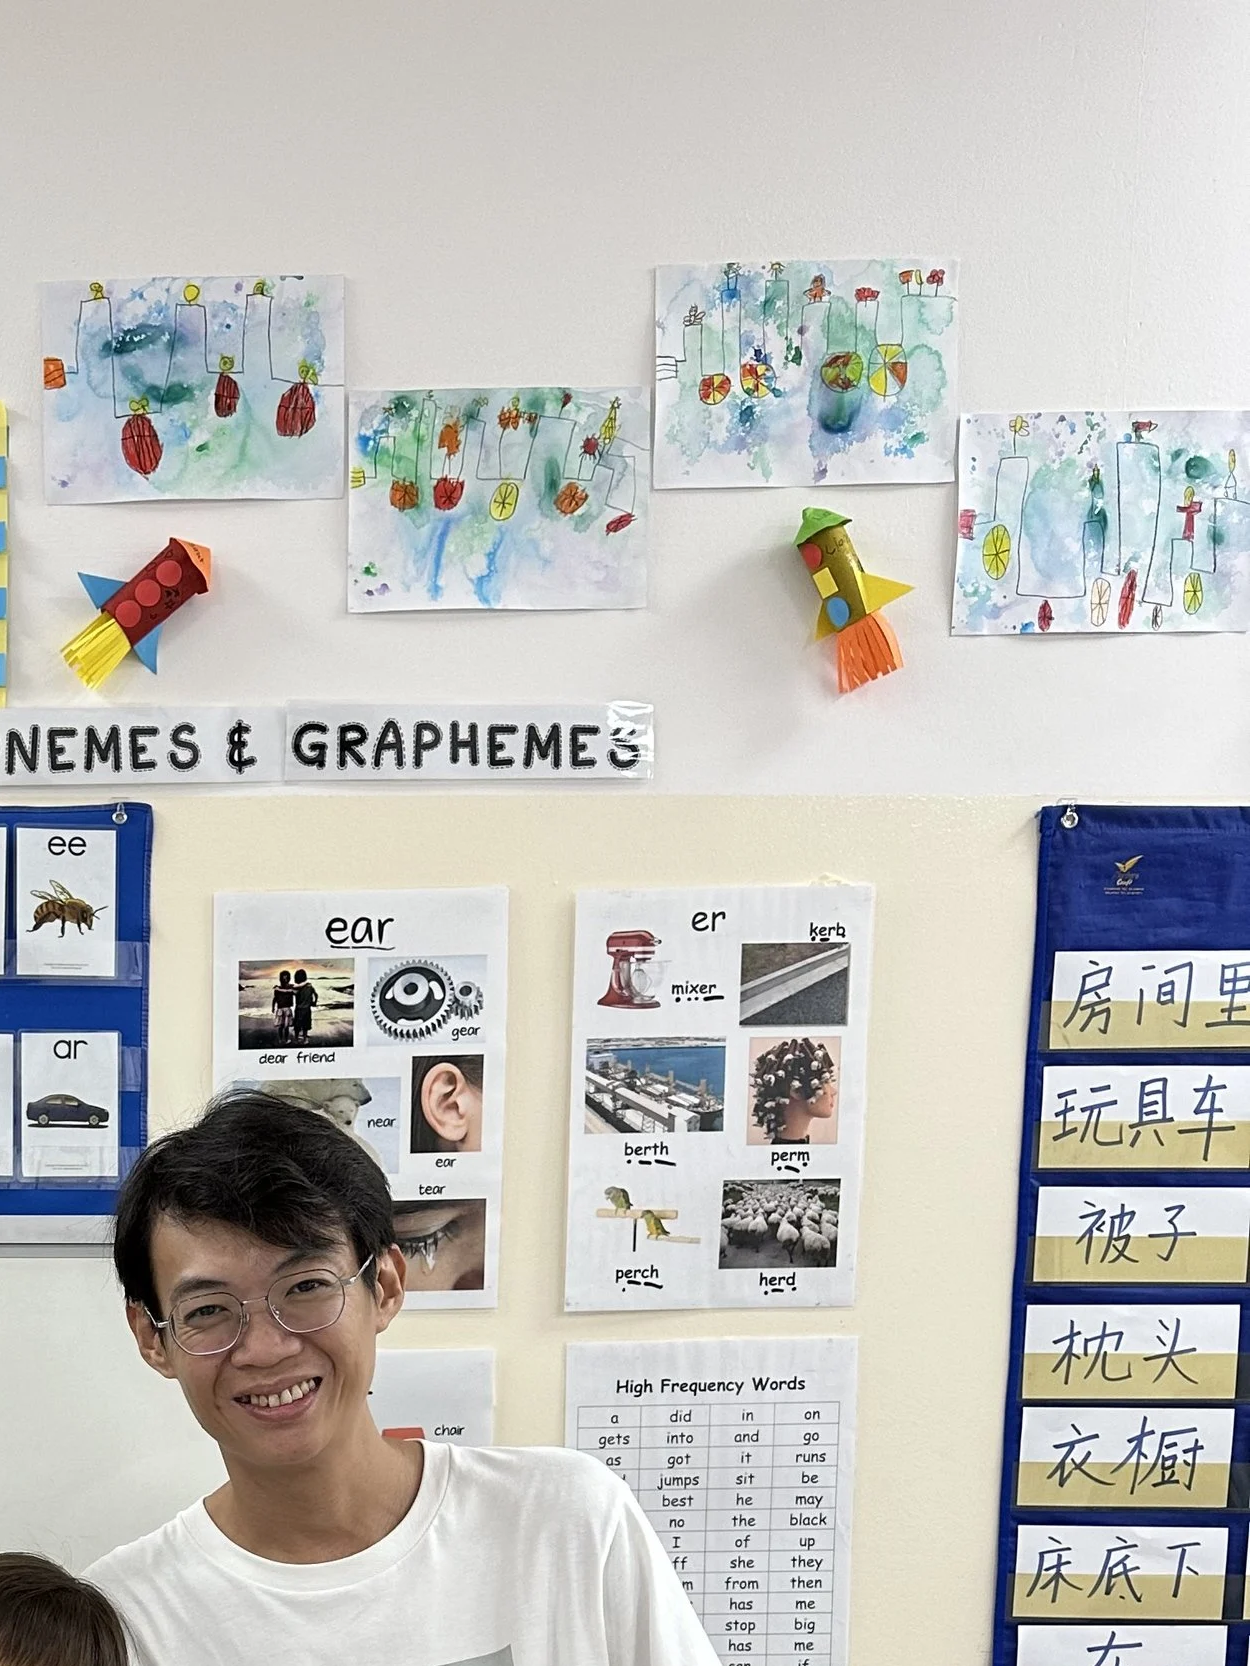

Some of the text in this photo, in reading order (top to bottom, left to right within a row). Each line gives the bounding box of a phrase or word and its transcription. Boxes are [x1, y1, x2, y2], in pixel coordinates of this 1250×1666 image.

[227, 719, 252, 777] &
[291, 719, 643, 771] GRAPHEMES
[48, 836, 86, 856] ee
[692, 904, 726, 931] er
[325, 917, 394, 944] ear
[810, 922, 846, 938] kerb
[672, 981, 716, 995] mixer
[1062, 962, 1250, 1033] 房间里
[452, 1027, 480, 1041] gear
[53, 1040, 88, 1059] ar
[259, 1051, 335, 1064] dear friend
[368, 1118, 396, 1128] near
[1054, 1073, 1237, 1161] 玩具车
[625, 1141, 668, 1156] berth
[435, 1159, 456, 1167] ear
[771, 1151, 810, 1167] perm
[419, 1185, 446, 1195] tear
[1077, 1200, 1199, 1264] 被子
[616, 1265, 658, 1283] perch
[760, 1272, 795, 1286] herd
[1051, 1319, 1199, 1387] 枕头
[616, 1376, 805, 1397] High Frequency Words
[611, 1415, 618, 1424] a
[670, 1410, 691, 1422] did
[742, 1412, 753, 1421] in
[805, 1411, 820, 1420] on
[435, 1425, 464, 1436] chair
[734, 1430, 759, 1442] and
[599, 1434, 630, 1449] gets
[667, 1432, 693, 1444] into
[803, 1432, 819, 1445] go
[606, 1457, 621, 1466] as
[667, 1454, 691, 1469] got
[741, 1453, 752, 1463] it
[796, 1453, 826, 1463] runs
[1046, 1415, 1207, 1497] 衣橱
[657, 1476, 699, 1490] jumps
[736, 1474, 754, 1485] sit
[802, 1472, 818, 1483] be
[663, 1495, 693, 1507] best
[736, 1493, 753, 1505] he
[796, 1496, 823, 1508] may
[670, 1519, 684, 1528] no
[732, 1514, 755, 1527] the
[790, 1513, 826, 1526] black
[673, 1537, 680, 1548] I
[735, 1535, 750, 1548] of
[800, 1538, 815, 1551] up
[673, 1556, 688, 1570] ff
[730, 1556, 754, 1568] she
[791, 1555, 823, 1571] they
[1026, 1535, 1203, 1605] 床底下
[725, 1577, 758, 1590] from
[790, 1576, 822, 1588] then
[730, 1598, 753, 1610] has
[796, 1601, 815, 1610] me
[725, 1620, 755, 1635] stop
[795, 1618, 815, 1634] big
[729, 1639, 752, 1651] has
[794, 1642, 814, 1651] me
